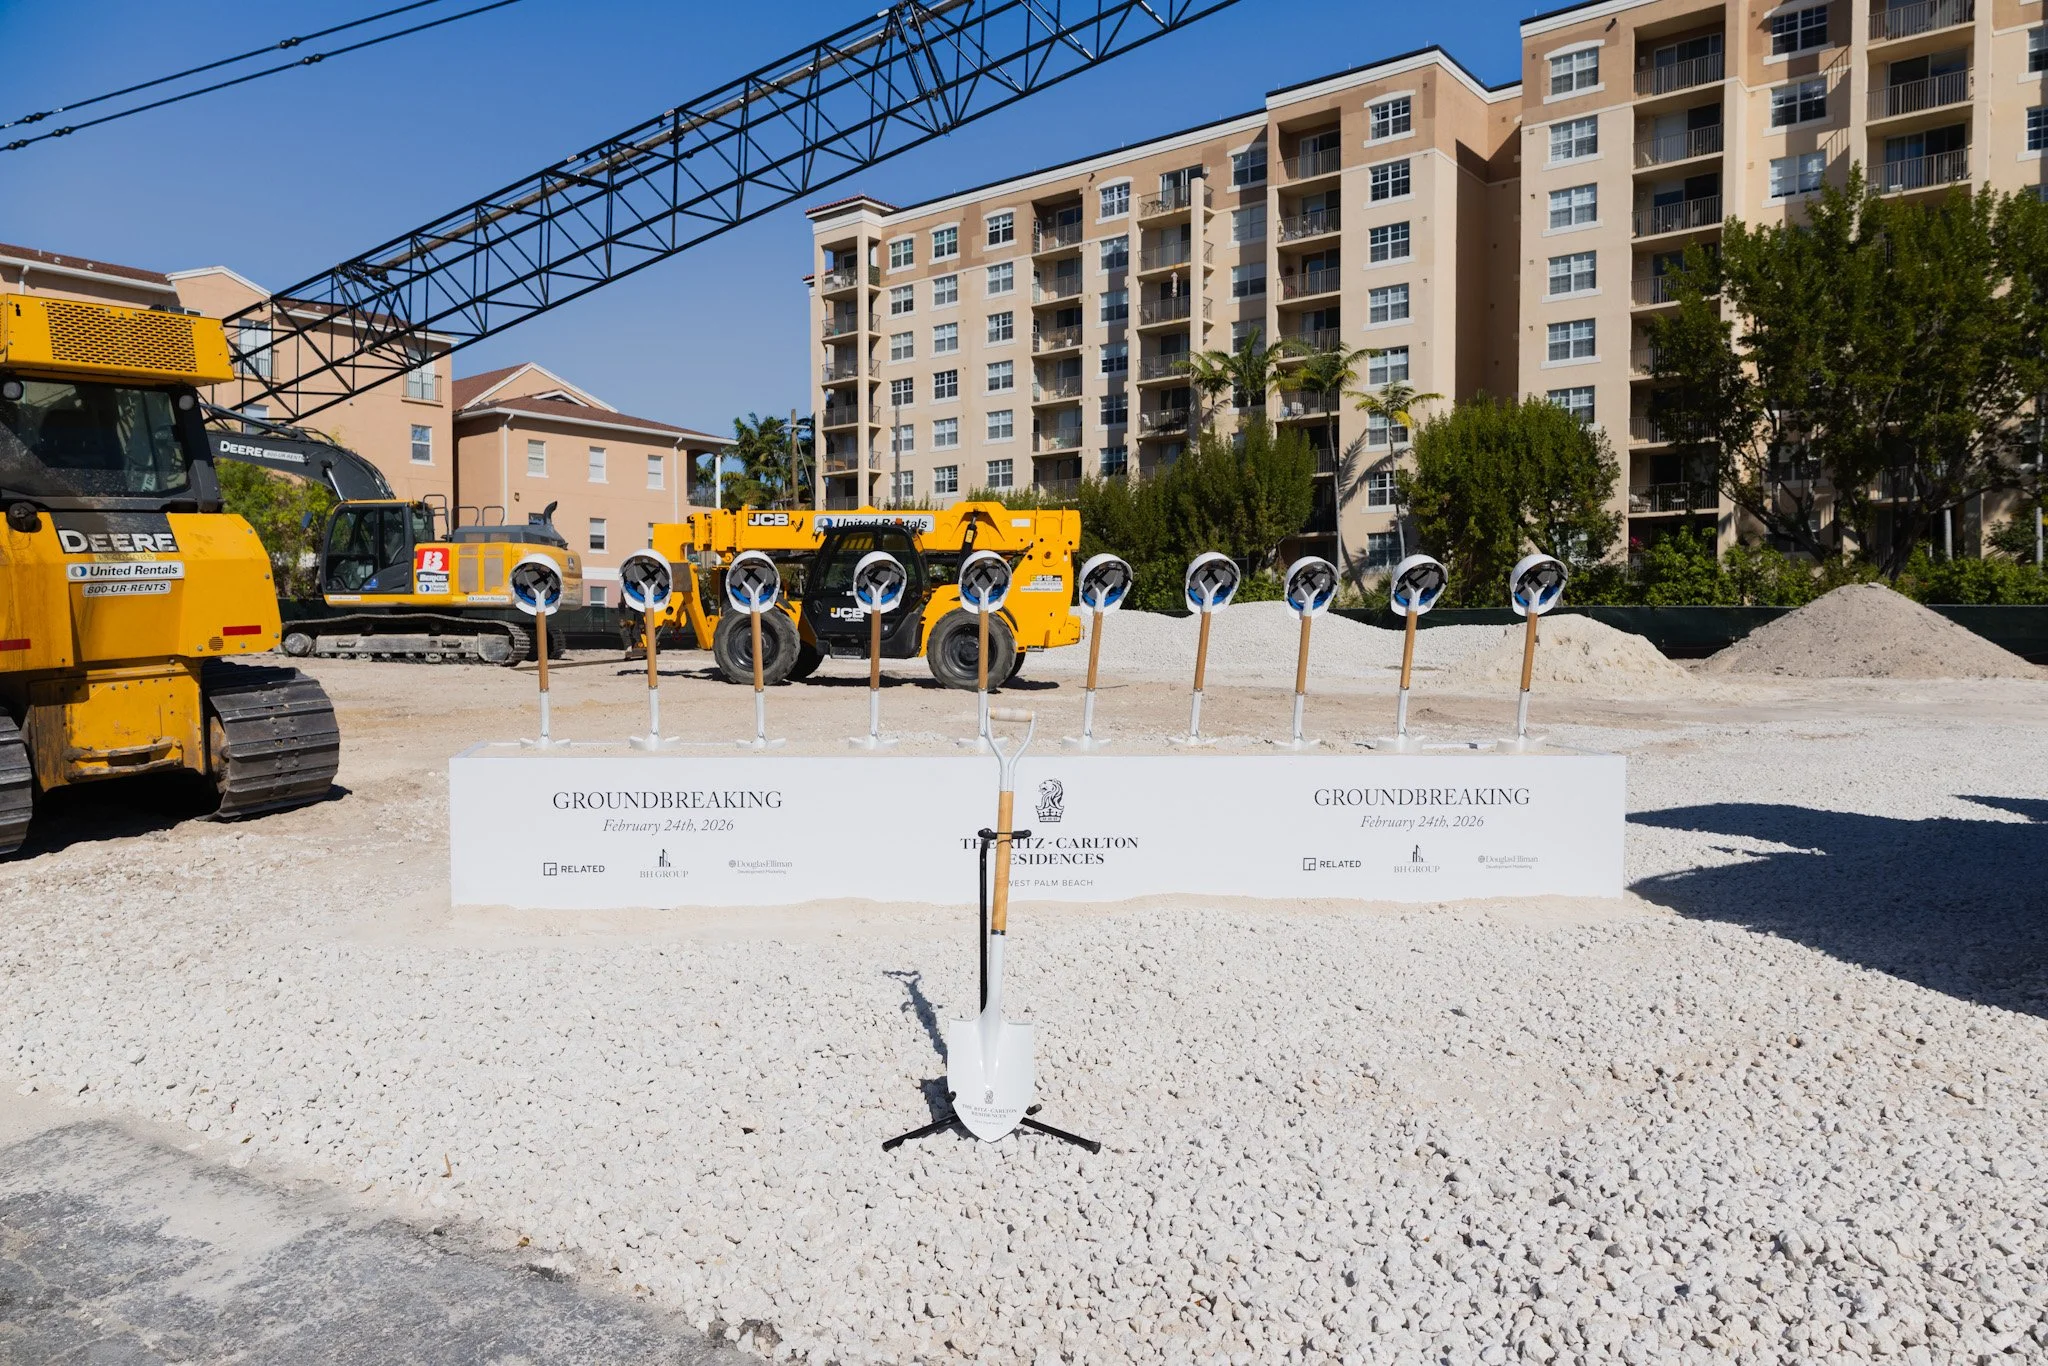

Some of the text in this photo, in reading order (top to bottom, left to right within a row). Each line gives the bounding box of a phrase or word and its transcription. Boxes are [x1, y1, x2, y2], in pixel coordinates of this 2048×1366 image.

[220, 440, 263, 457] DEERE
[748, 513, 789, 526] JCB
[882, 518, 928, 529] Retals
[58, 530, 177, 552] DEERE
[90, 564, 178, 576] United Rentals
[87, 583, 166, 594] 800-UR-RENTS
[830, 607, 865, 619] JCB
[553, 791, 783, 809] GROUNDBREAKING
[1314, 788, 1530, 806] GROUNDBREAKING
[602, 818, 734, 836] February 24th, 2026
[1360, 815, 1484, 832] February 24th, 2026
[1010, 853, 1104, 865] ESIDENCES
[1320, 860, 1362, 868] RELATED
[561, 865, 606, 873] RELATED
